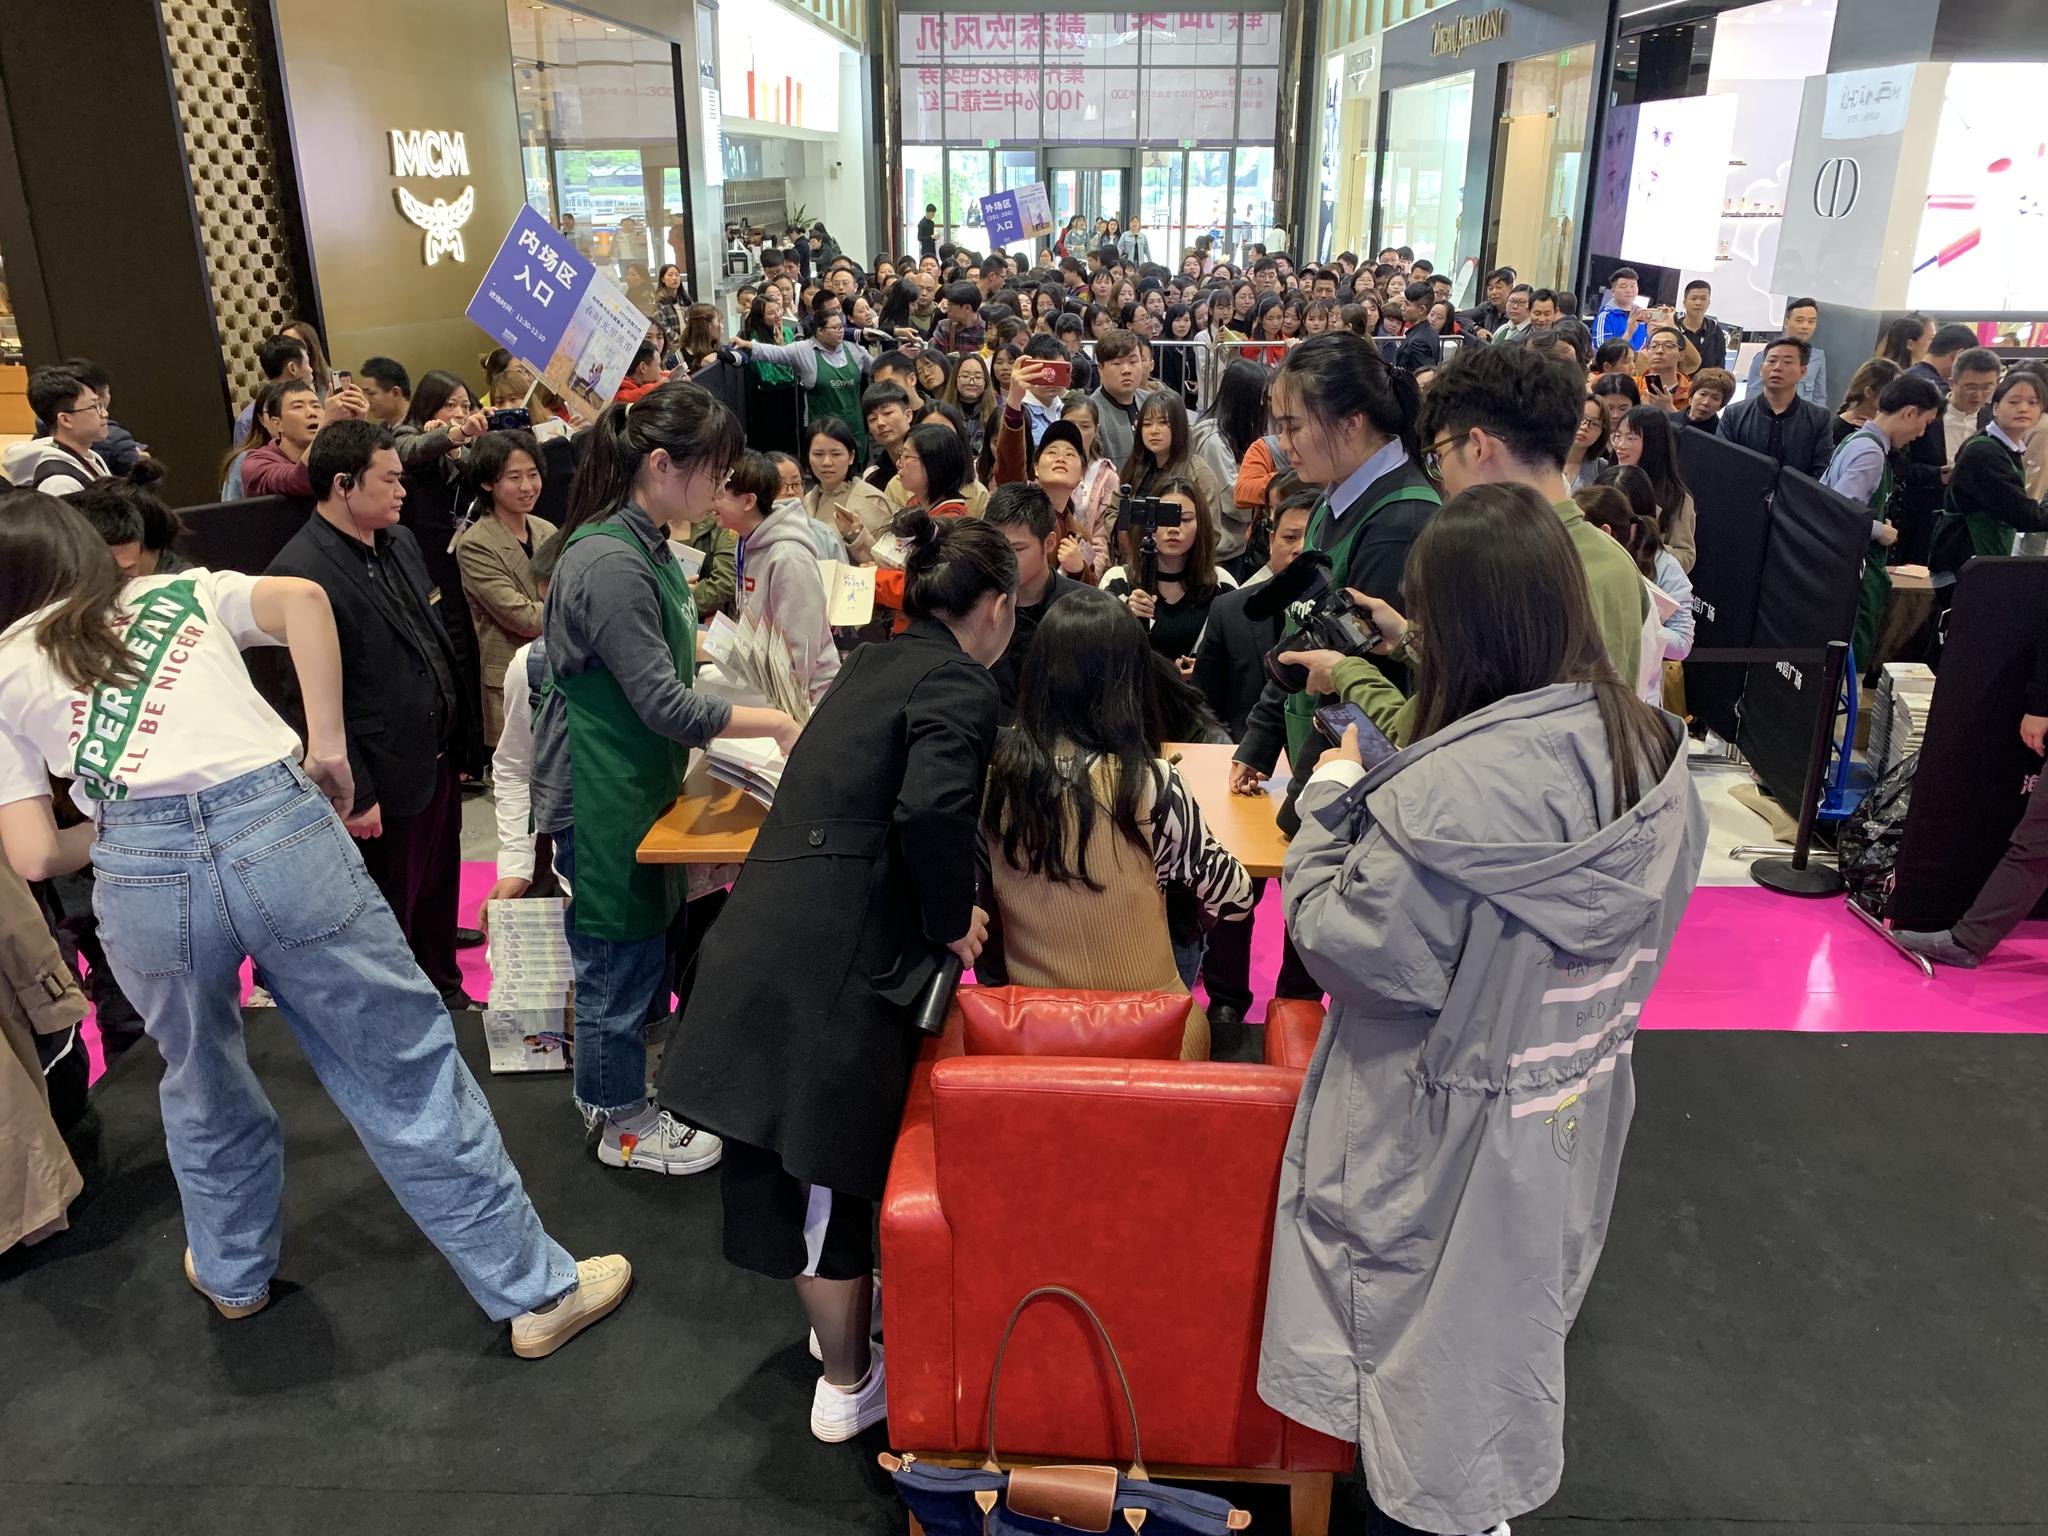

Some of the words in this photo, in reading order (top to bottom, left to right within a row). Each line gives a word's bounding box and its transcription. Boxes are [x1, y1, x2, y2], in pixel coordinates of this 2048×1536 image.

[390, 129, 469, 178] MCM
[996, 220, 1014, 233] 入口
[518, 228, 579, 291] 内场区
[513, 264, 555, 308] 入口
[138, 701, 166, 735] BE
[154, 624, 205, 691] NICER
